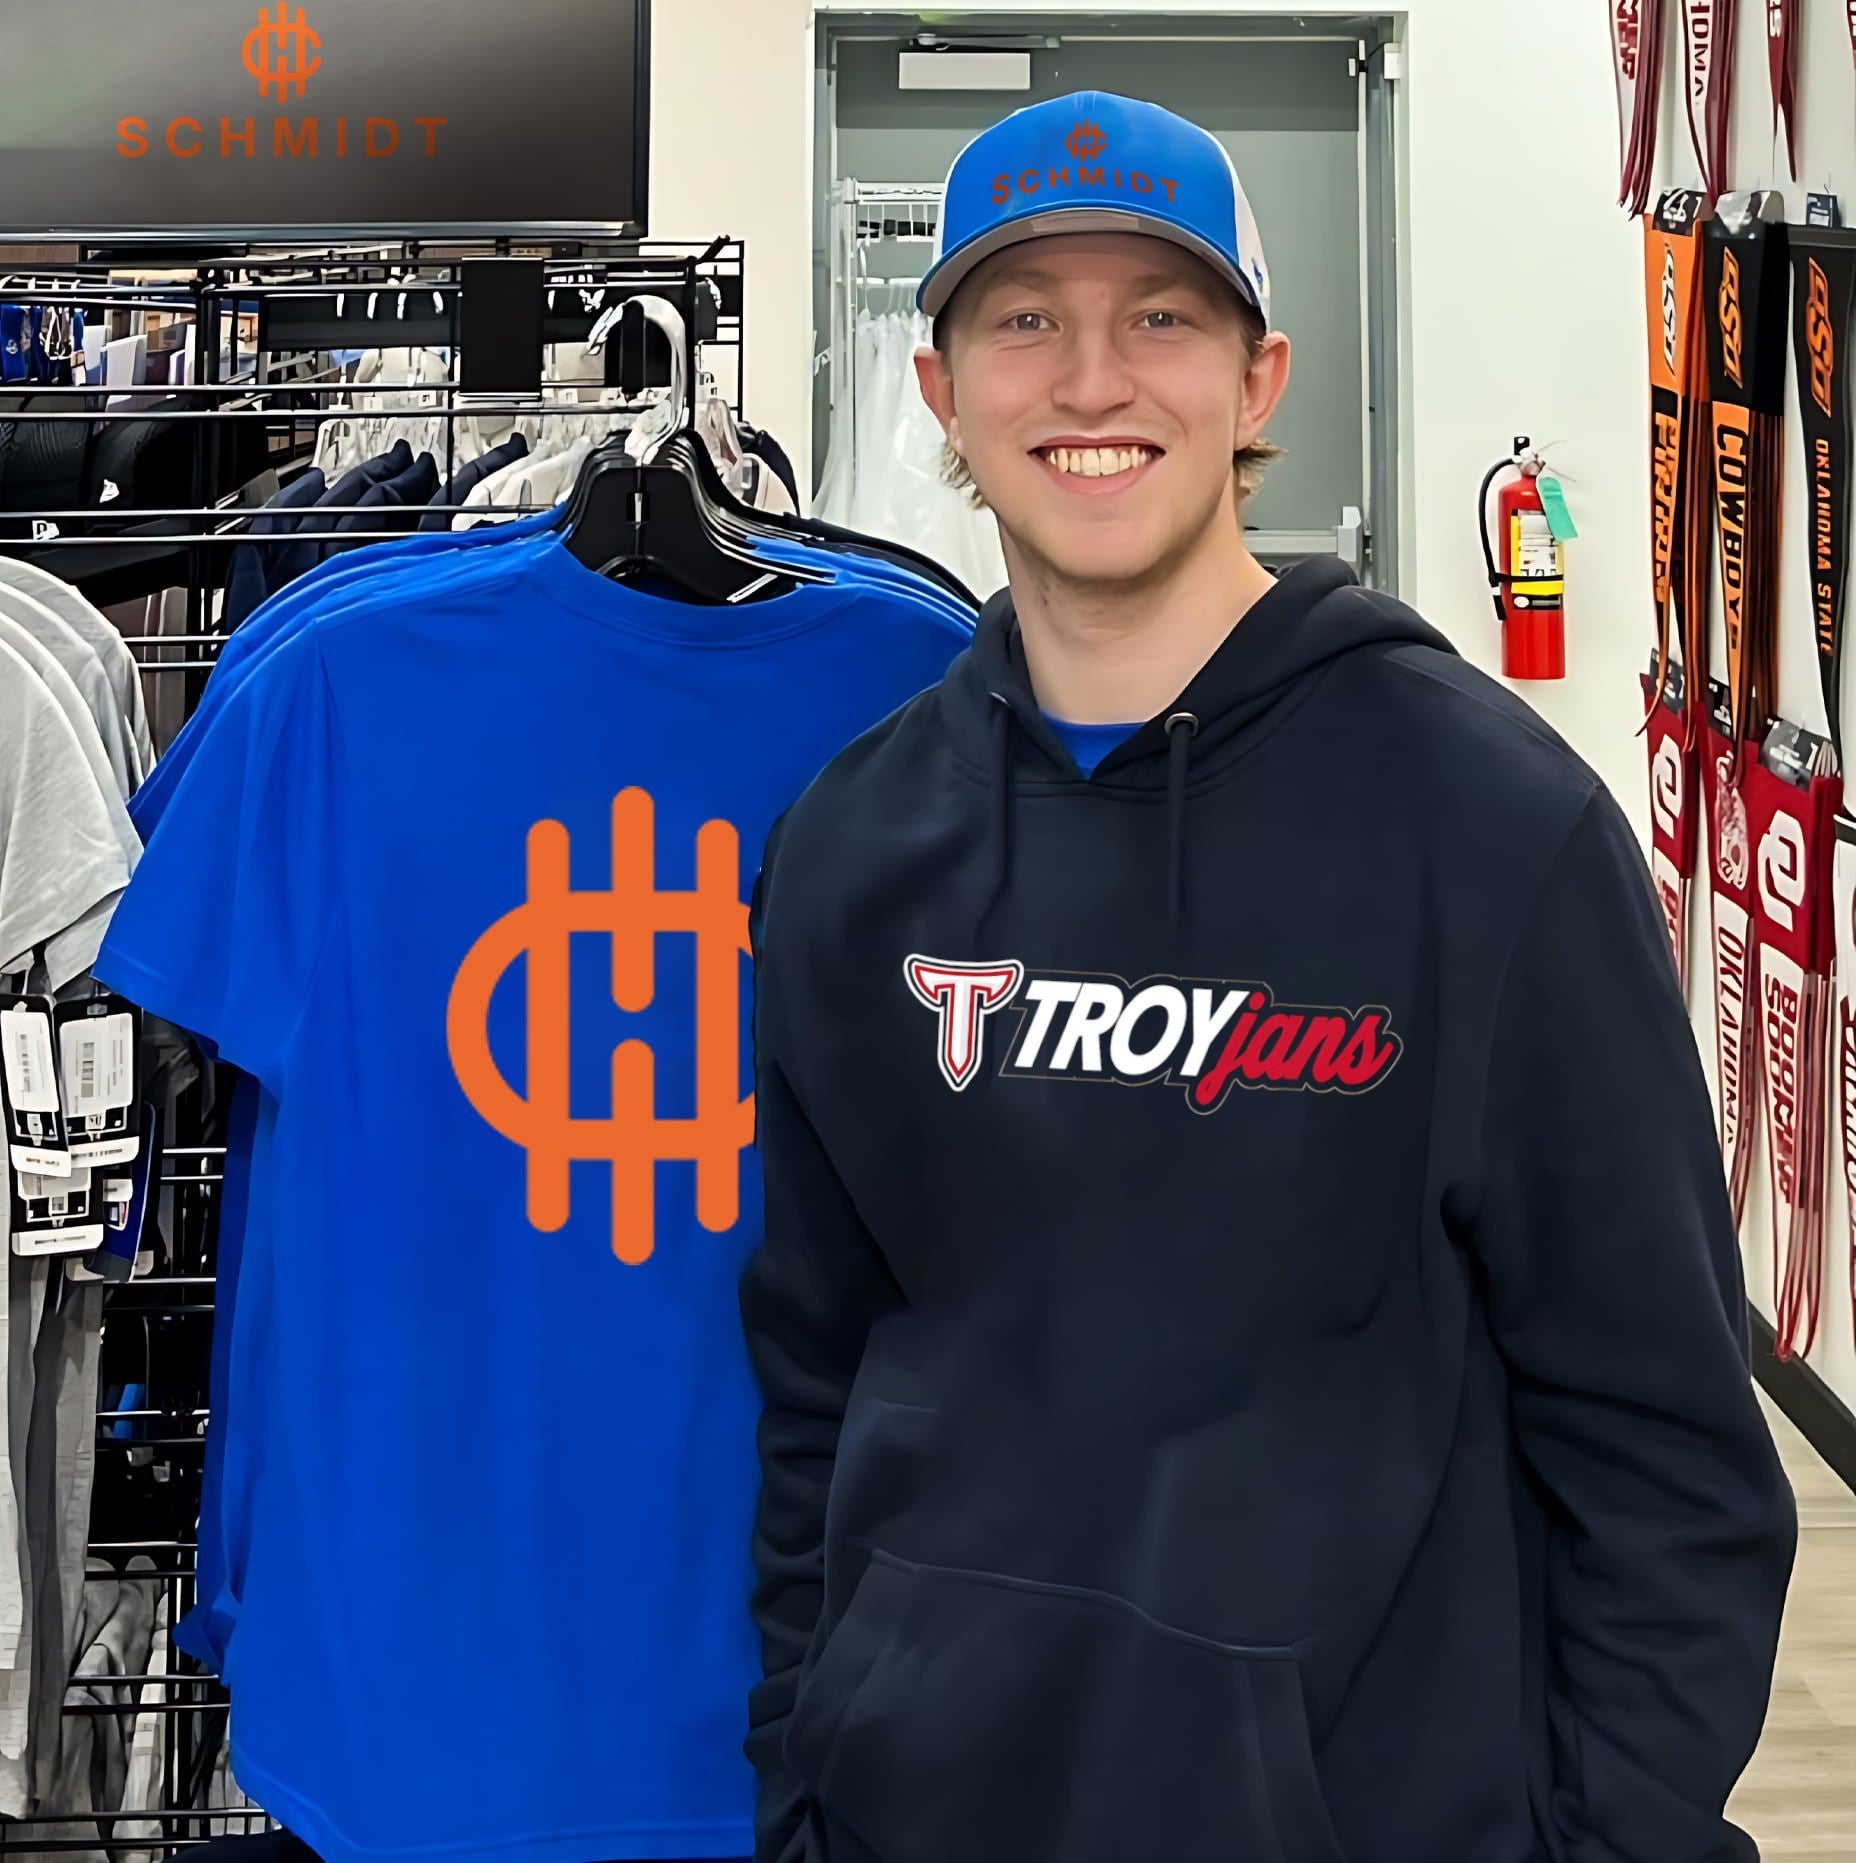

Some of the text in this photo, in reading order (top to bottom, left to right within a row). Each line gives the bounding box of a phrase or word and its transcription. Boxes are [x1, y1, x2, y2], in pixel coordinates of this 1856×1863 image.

[116, 116, 449, 159] SCHMIDT
[991, 166, 1180, 205] SCHMIDT
[1815, 438, 1832, 570] OKLAHOMA
[1718, 925, 1745, 1144] OKLAHOMA
